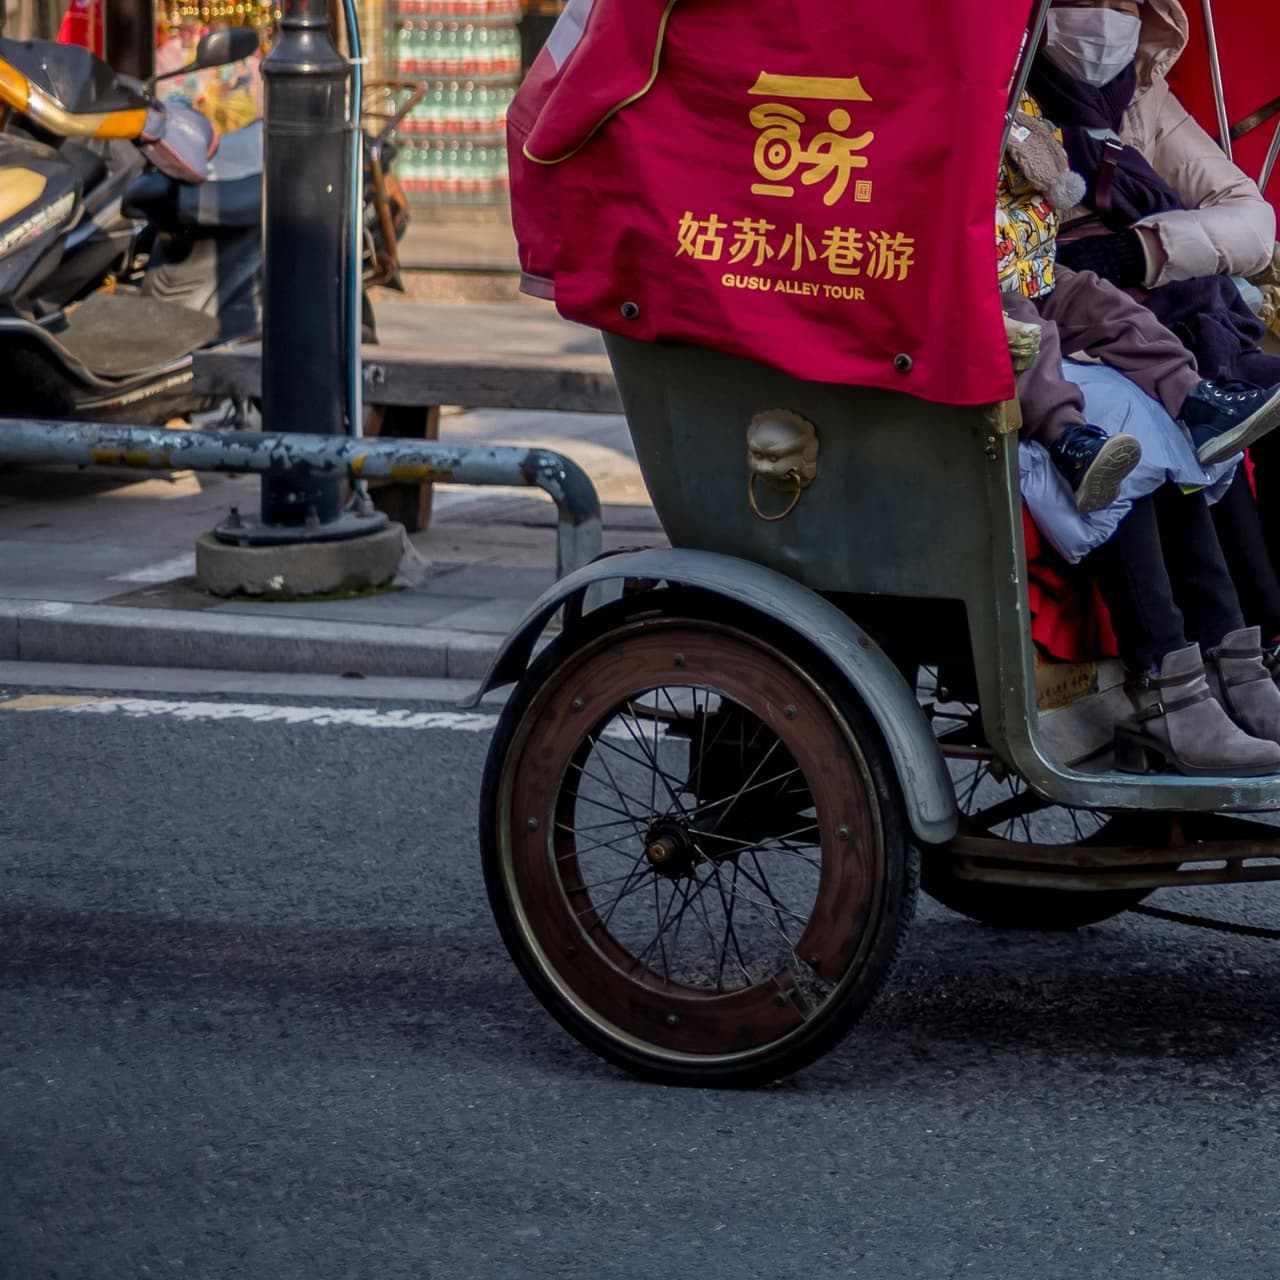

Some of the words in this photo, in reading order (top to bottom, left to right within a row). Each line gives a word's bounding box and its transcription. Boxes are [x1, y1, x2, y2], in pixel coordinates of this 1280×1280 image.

[675, 210, 916, 281] 姑苏小巷游
[721, 272, 772, 292] GUSU
[774, 279, 820, 297] ALLEY
[823, 284, 866, 301] TOUR
